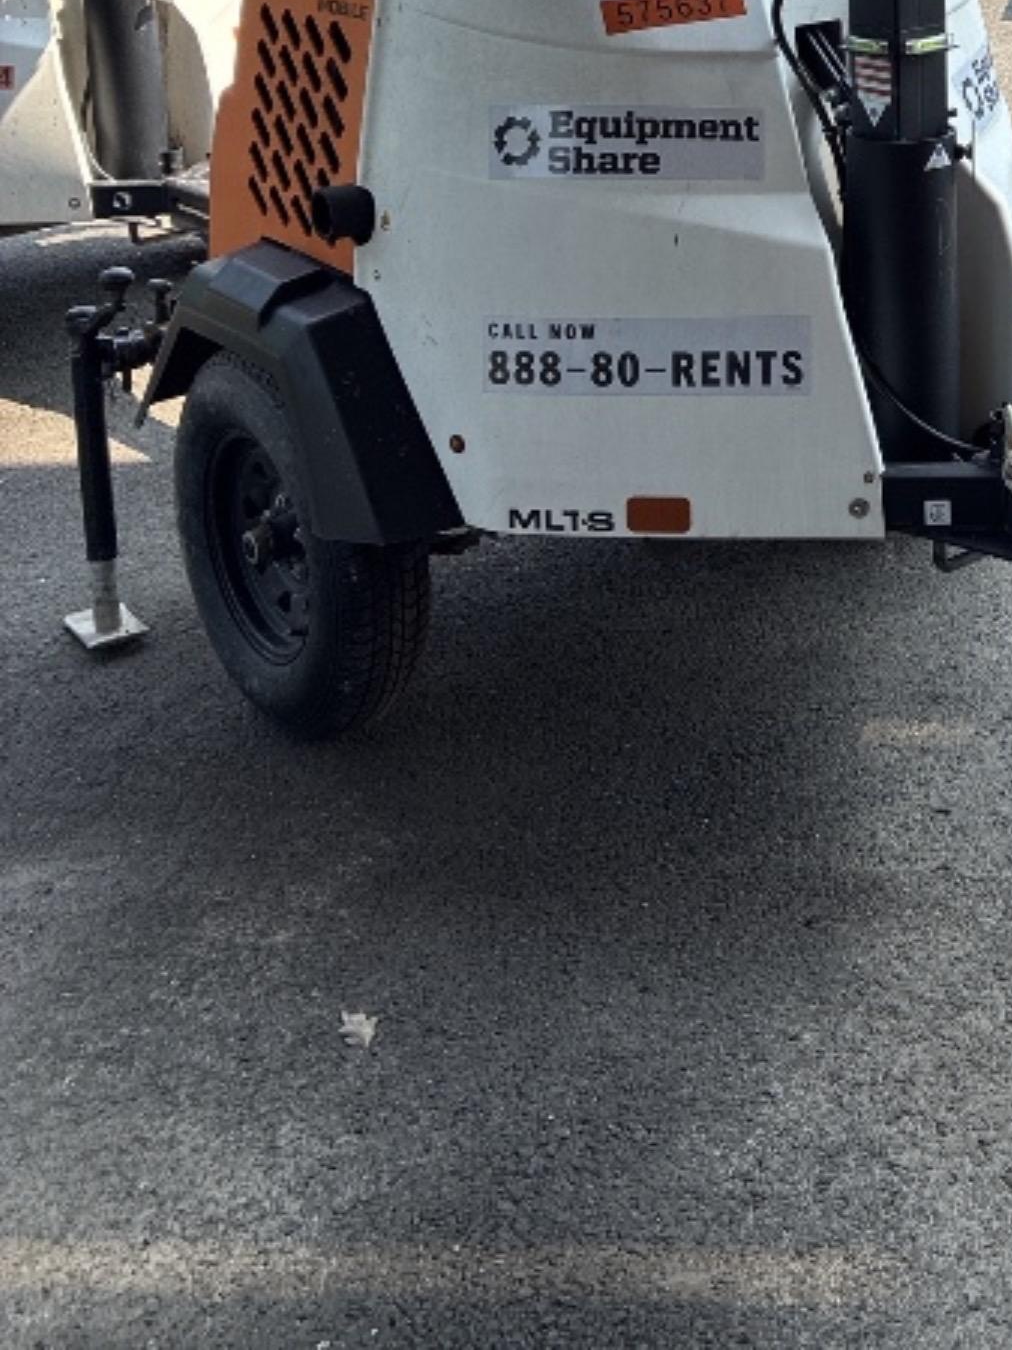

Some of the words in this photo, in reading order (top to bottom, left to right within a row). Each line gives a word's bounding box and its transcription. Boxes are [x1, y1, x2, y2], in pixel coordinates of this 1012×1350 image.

[549, 111, 760, 144] Equipment
[548, 147, 661, 174] Share
[488, 323, 538, 340] CALL
[549, 323, 596, 340] NOW
[488, 349, 805, 388] 888-80-RENTS
